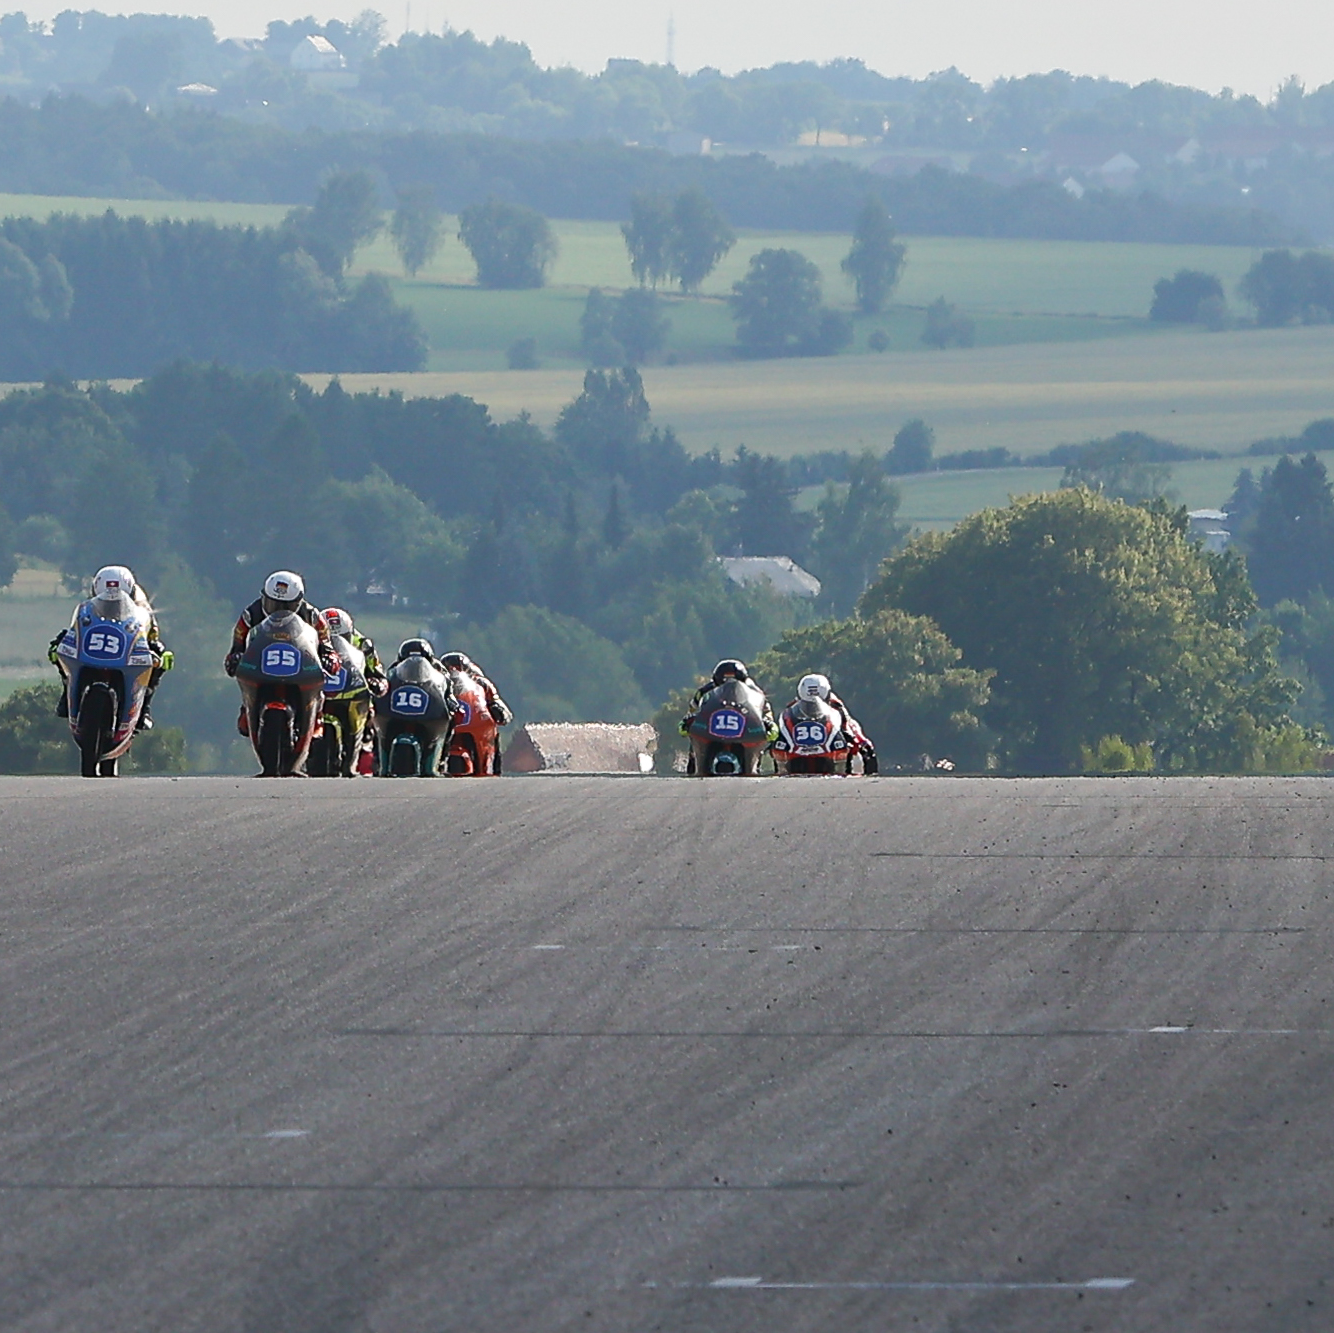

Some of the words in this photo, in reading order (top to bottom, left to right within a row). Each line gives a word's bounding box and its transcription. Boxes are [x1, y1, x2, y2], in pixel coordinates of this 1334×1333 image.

[88, 633, 120, 654] 53
[266, 650, 296, 666] 55
[396, 691, 422, 708] 16
[715, 715, 739, 731] 15
[796, 725, 822, 741] 36
